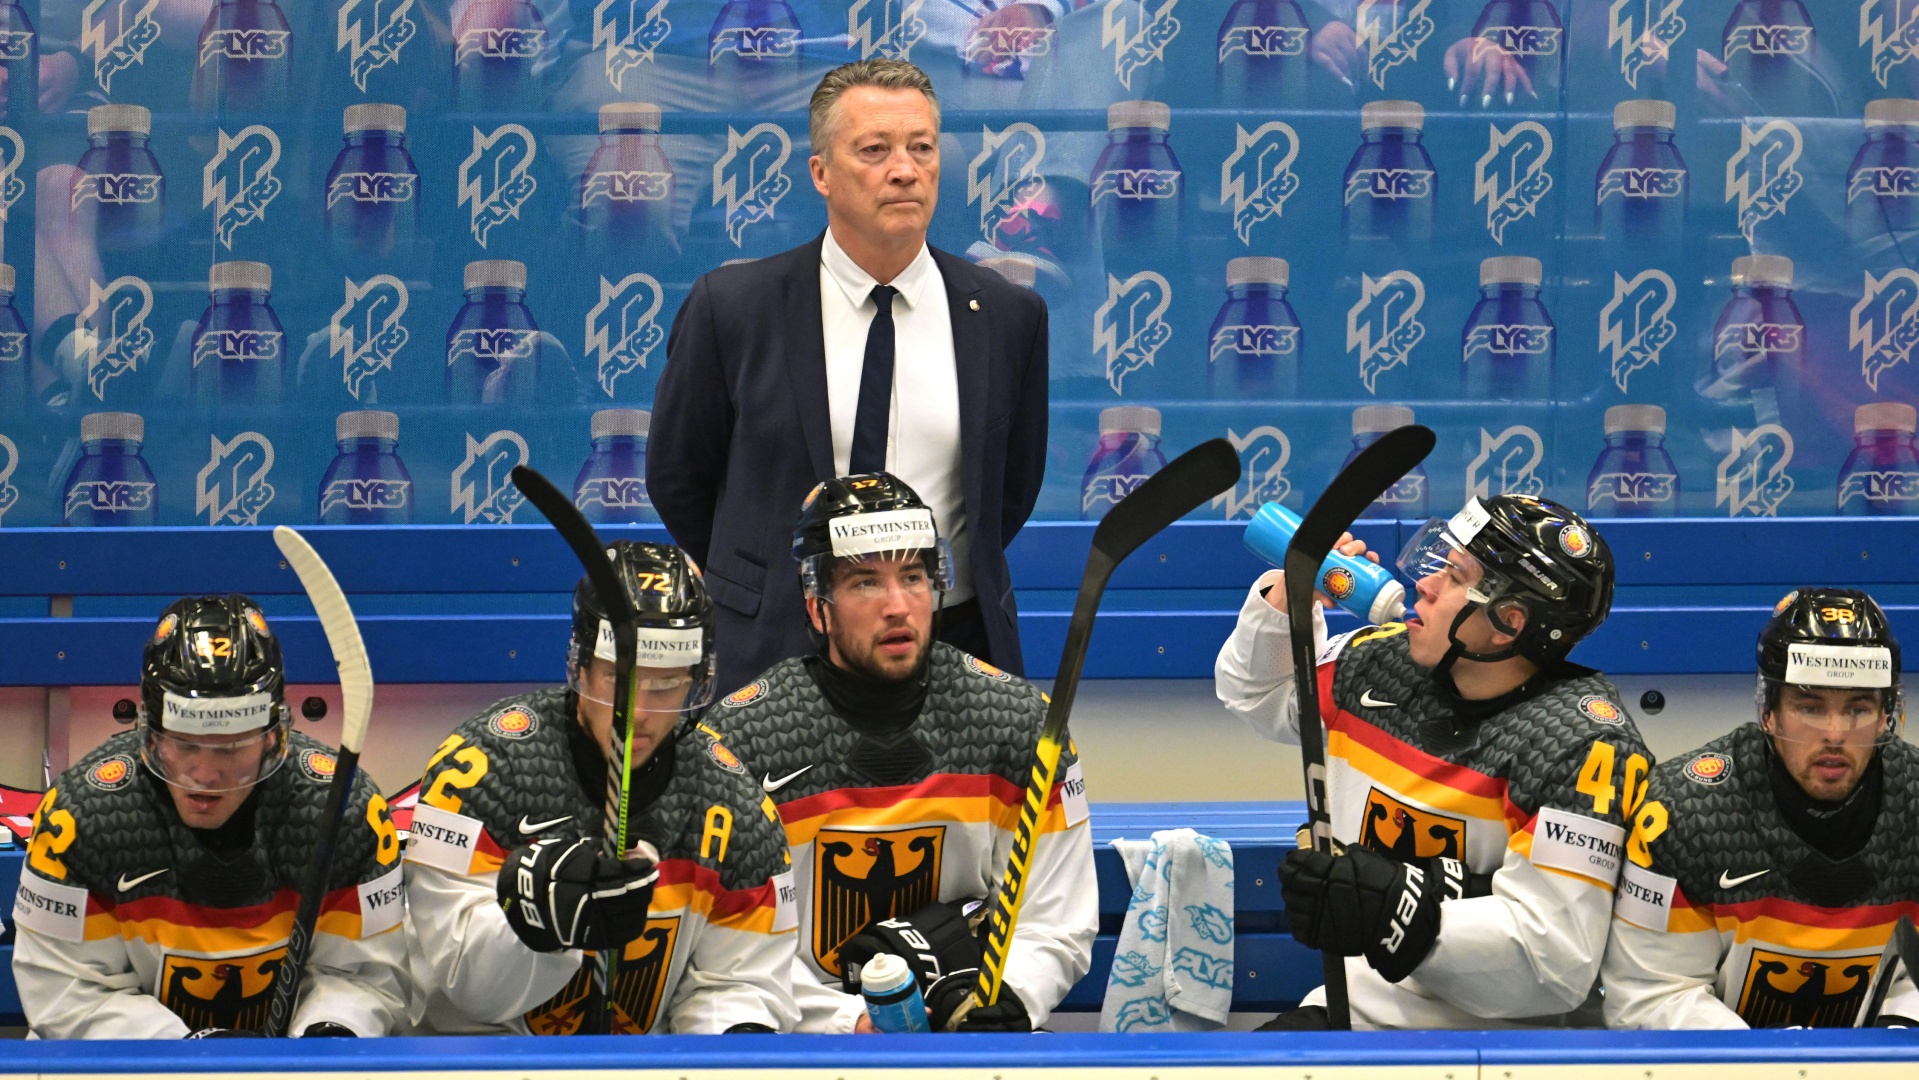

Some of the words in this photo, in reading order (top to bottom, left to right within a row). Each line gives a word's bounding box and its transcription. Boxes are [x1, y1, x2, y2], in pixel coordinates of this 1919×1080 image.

[199, 29, 288, 66] PLYRS
[455, 28, 544, 65] PLYRS
[710, 27, 799, 64] PLYRS
[965, 26, 1054, 63] PLYRS
[1219, 26, 1308, 63] PLYRS
[1473, 26, 1562, 63] PLYRS
[1724, 25, 1813, 62] PLYRS
[72, 173, 161, 210] PLYRS
[327, 172, 416, 209] PLYRS
[583, 170, 672, 207] PLYRS
[1091, 169, 1180, 206] PLYRS
[1345, 168, 1434, 205] PLYRS
[1597, 167, 1686, 204] PLYRS
[193, 330, 282, 367] PLYRS
[448, 328, 537, 365] PLYRS
[1210, 325, 1299, 362] PLYRS
[1463, 324, 1552, 361] PLYRS
[1714, 323, 1803, 360] PLYRS
[65, 481, 154, 518] PLYRS
[321, 479, 410, 516] PLYRS
[852, 480, 878, 489] 17
[1587, 473, 1676, 510] PLYRS
[834, 521, 930, 539] WESTMINSTER
[874, 534, 901, 543] GROUP
[638, 572, 672, 592] 72
[1821, 607, 1855, 623] 38
[602, 628, 699, 651] WMINSTER
[1791, 652, 1889, 671] WESTMINSTER
[1826, 670, 1855, 679] GROUP
[167, 701, 267, 719] WESTMINSTER
[700, 805, 733, 863] A
[1588, 855, 1616, 871] GROUP
